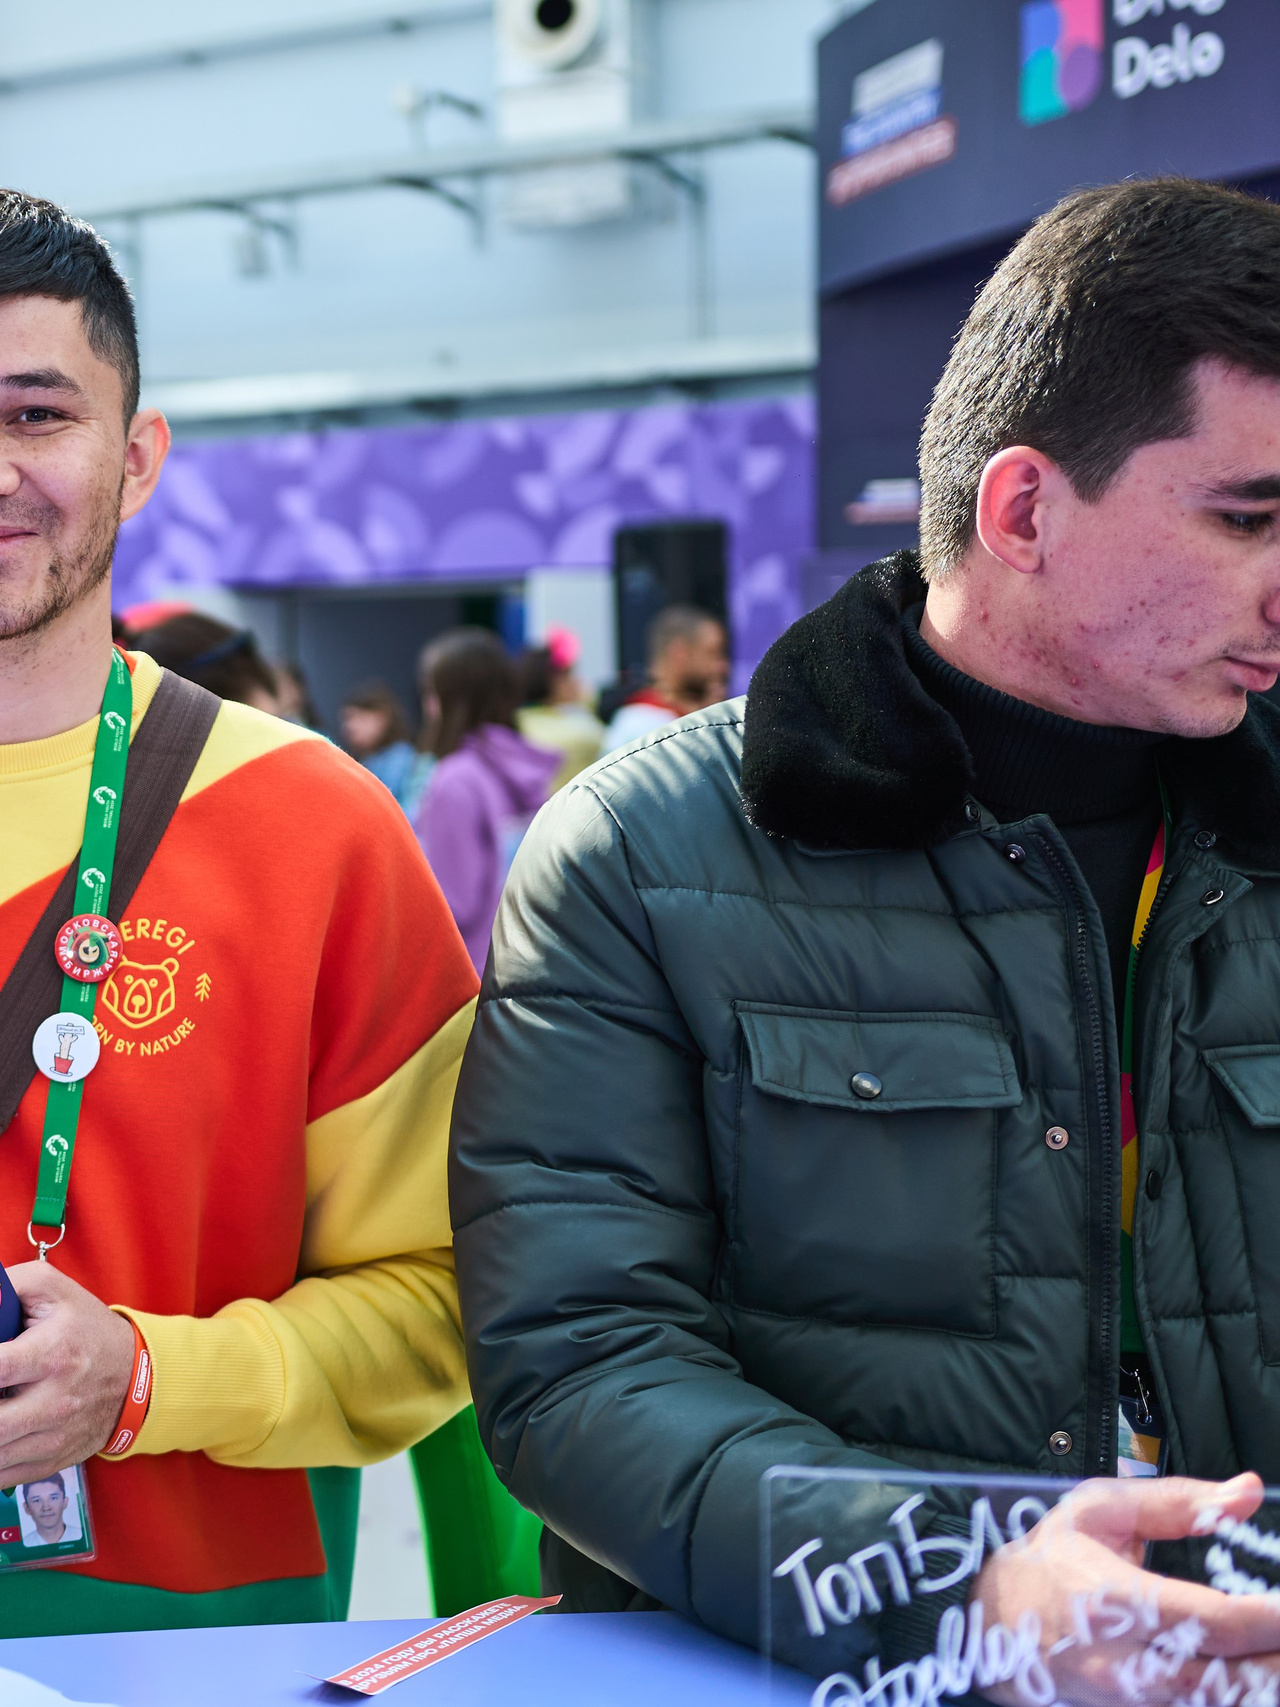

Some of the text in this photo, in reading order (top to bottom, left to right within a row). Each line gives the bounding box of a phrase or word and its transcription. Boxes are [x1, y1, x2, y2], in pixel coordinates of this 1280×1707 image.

[1112, 22, 1225, 99] Delo
[58, 918, 119, 959] МОСКОВСКАЯ
[120, 918, 195, 956] EREGI
[64, 960, 114, 979] БИРЖА
[114, 1039, 136, 1055] BY
[140, 1017, 196, 1057] NATURE
[338, 1602, 512, 1687] В 2024 ГОДУ ВЫ РАССКАЖЕТЕ
[352, 1661, 413, 1692] ДРУЗЬЯМ
[411, 1648, 438, 1663] ПРО
